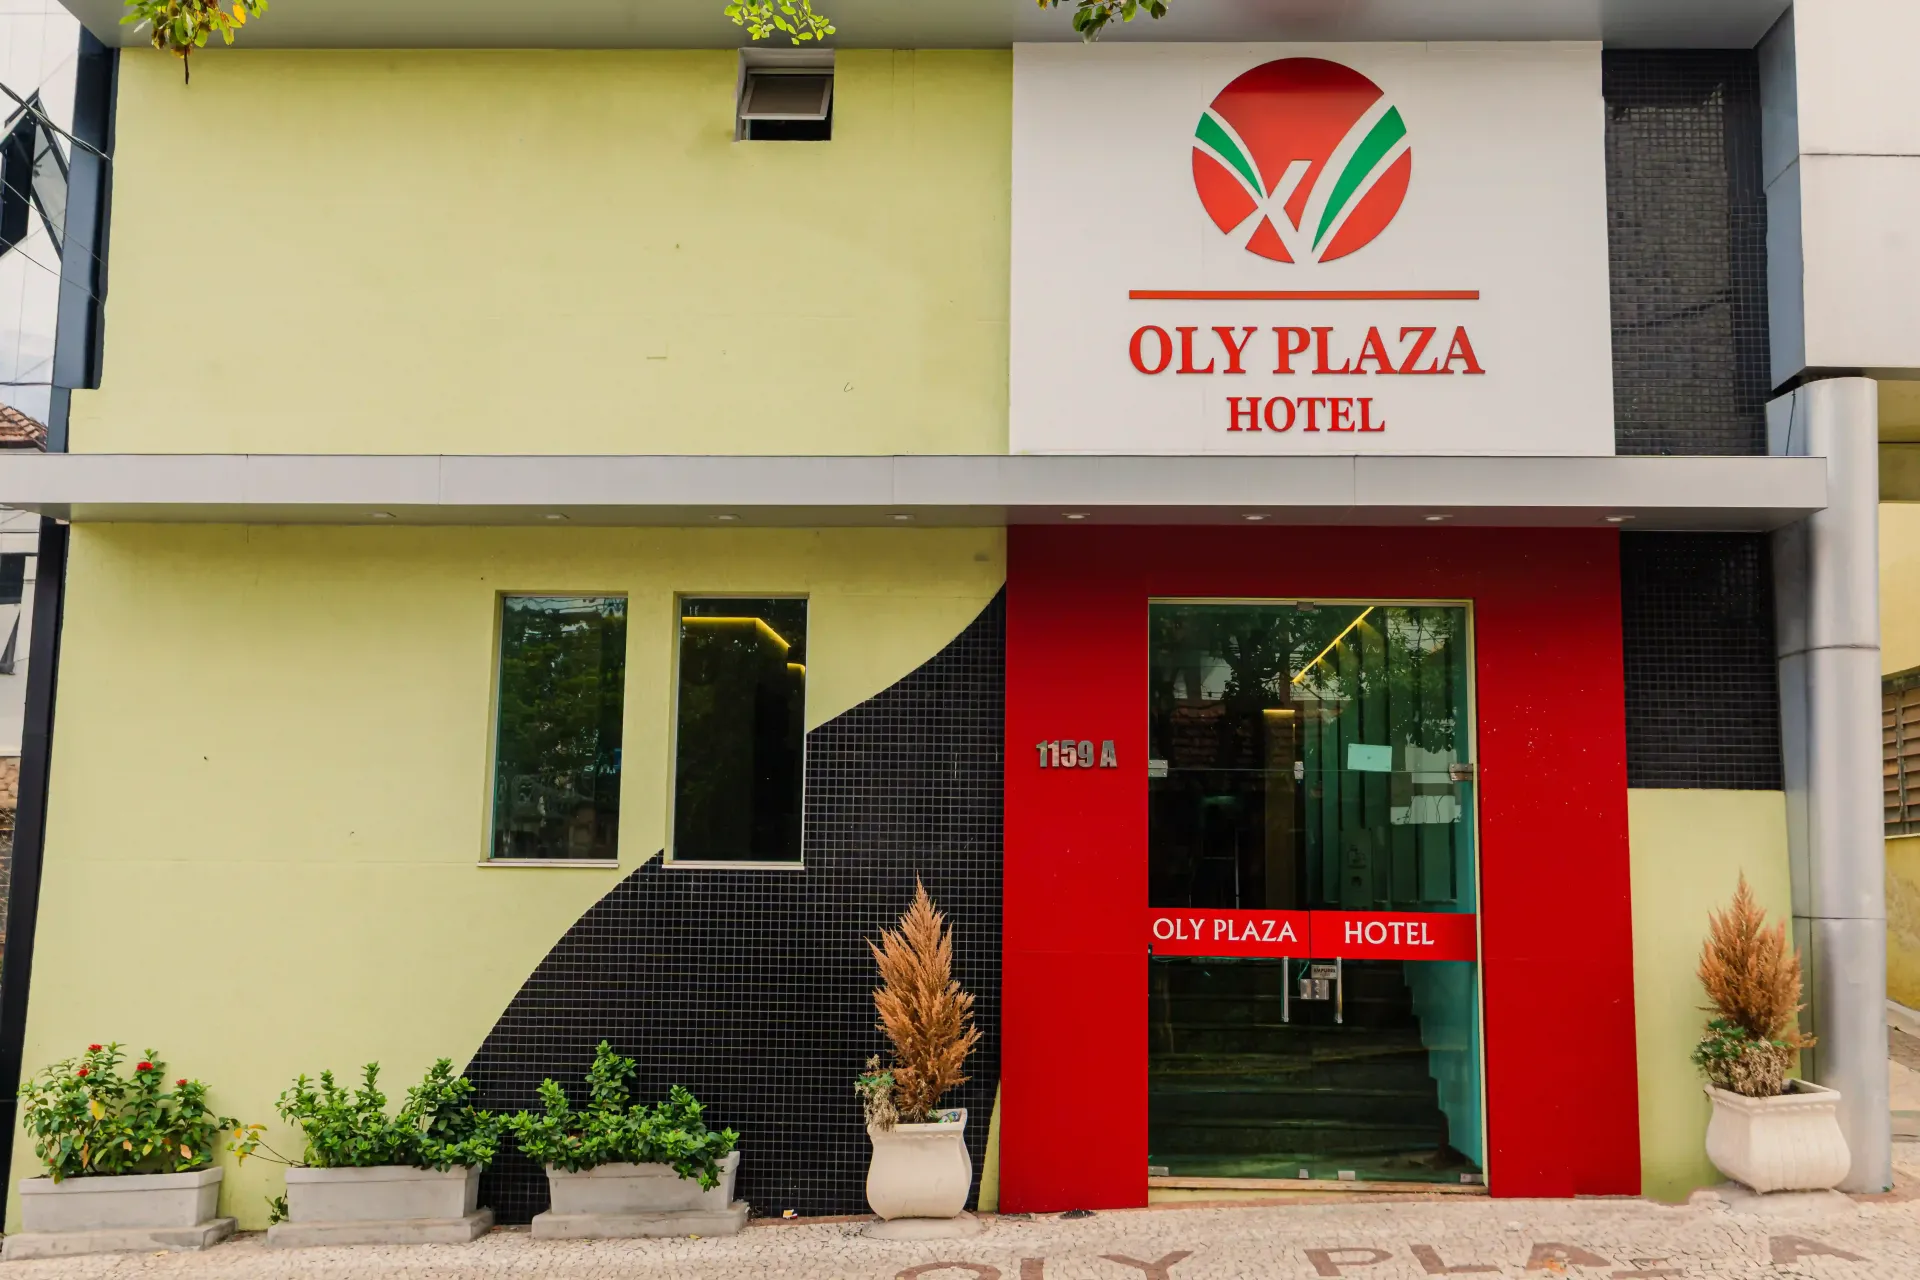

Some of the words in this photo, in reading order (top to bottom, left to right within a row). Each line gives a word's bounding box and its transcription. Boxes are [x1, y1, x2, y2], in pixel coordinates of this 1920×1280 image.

[1129, 325, 1257, 375] OLY
[1272, 325, 1485, 375] PLAZA
[1227, 396, 1385, 432] HOTEL
[1036, 740, 1094, 767] 1159
[1100, 740, 1117, 767] A
[1153, 918, 1205, 940] OLY
[1213, 919, 1297, 943] PLAZA
[1344, 921, 1434, 945] HOTEL
[1303, 1235, 1872, 1280] PLAA
